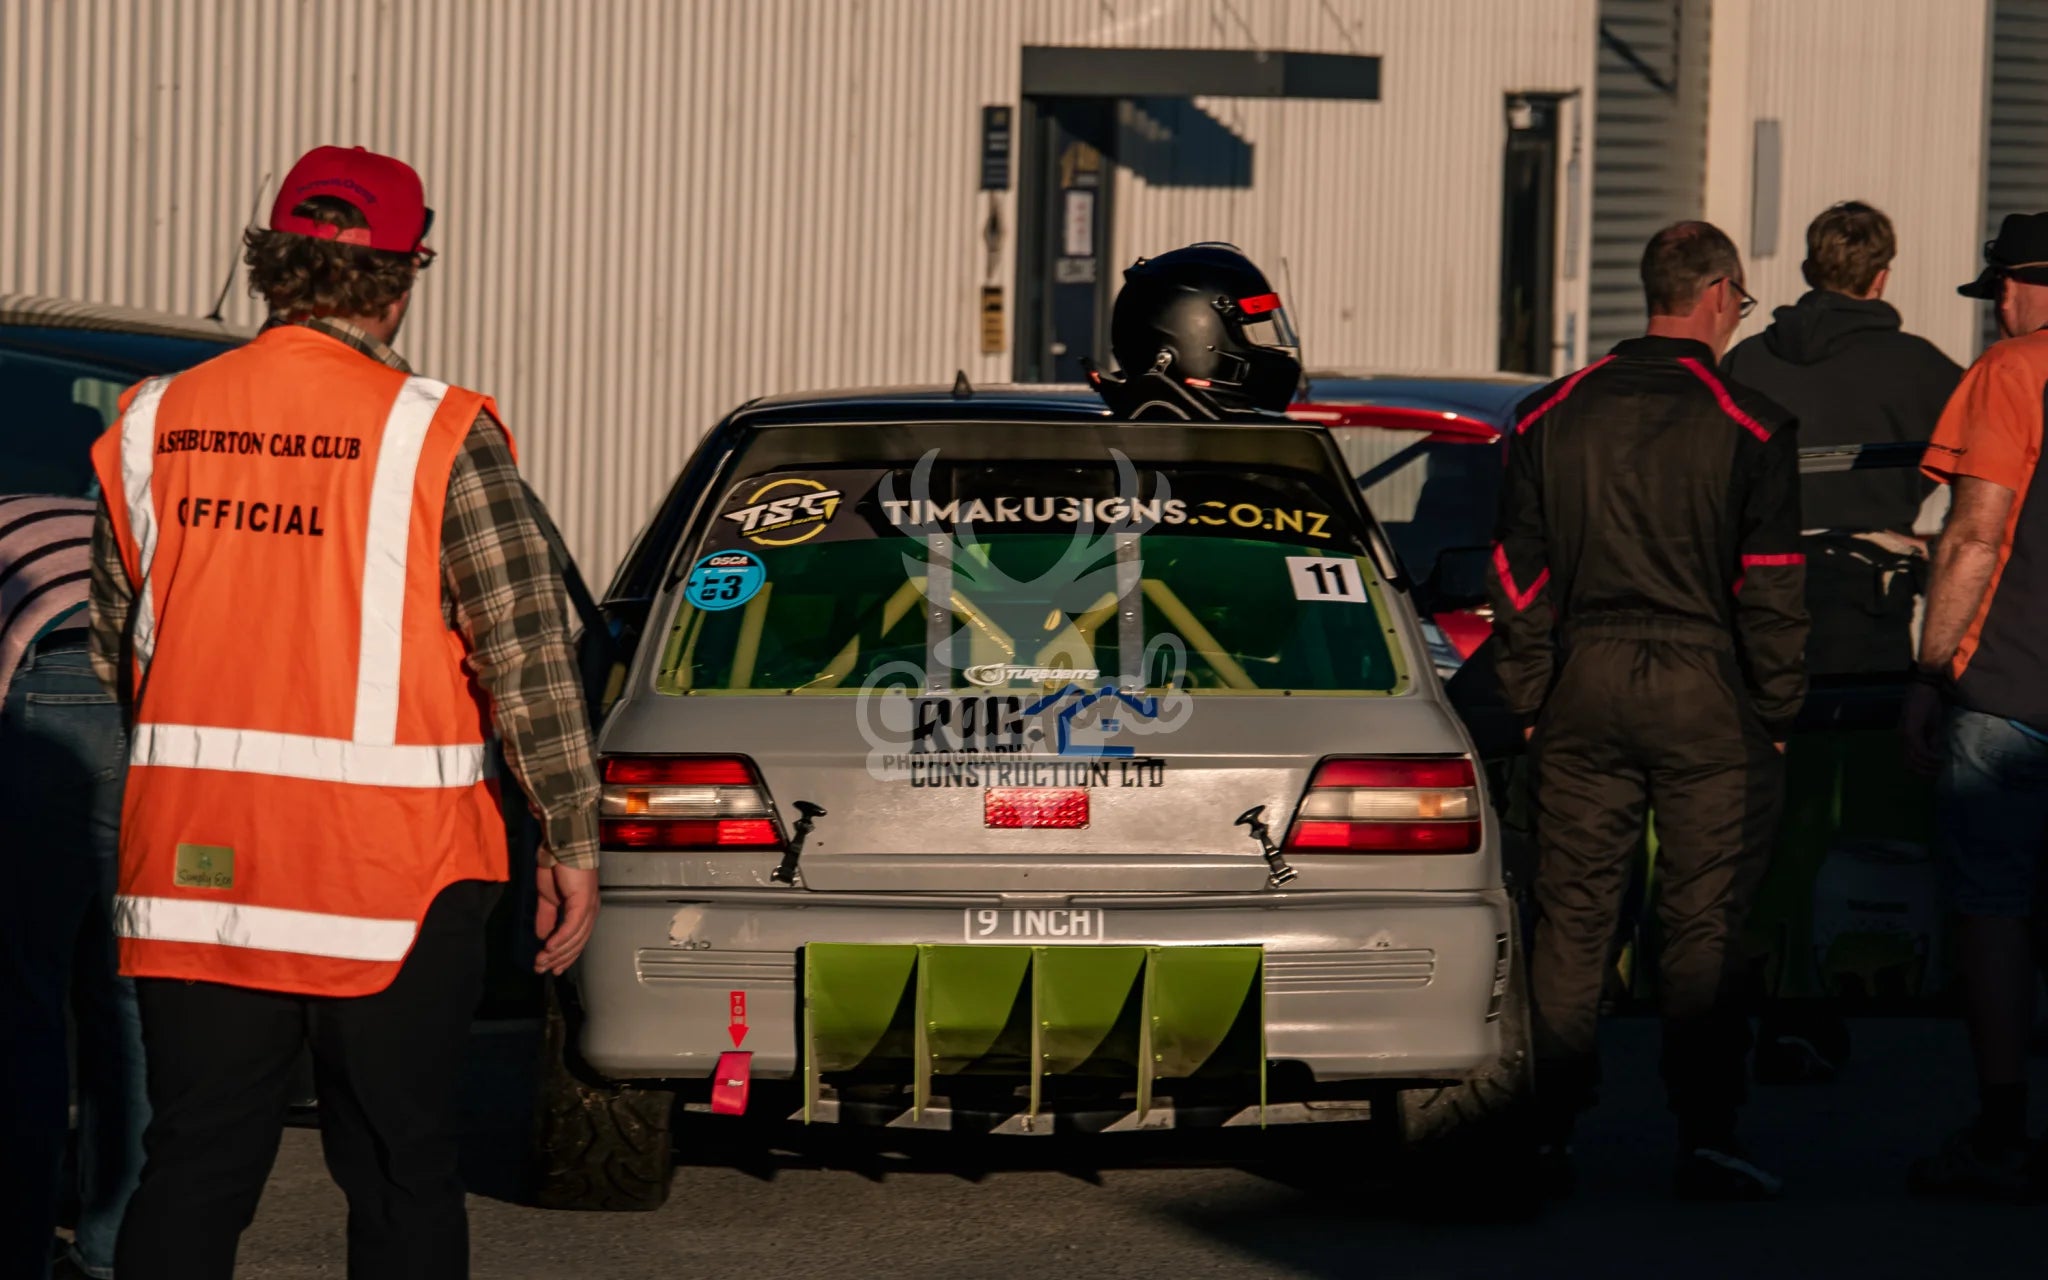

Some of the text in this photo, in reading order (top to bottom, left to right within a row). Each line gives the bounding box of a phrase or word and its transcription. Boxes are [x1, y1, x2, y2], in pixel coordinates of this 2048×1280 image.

[156, 429, 362, 460] ASHBURTON CAR CLUB
[177, 496, 325, 537] OFFICIAL
[882, 496, 1333, 539] TIMARUSIGNS.CO.NZ
[709, 556, 749, 567] OSCA
[720, 575, 743, 600] 3
[1304, 562, 1351, 596] 11
[1005, 668, 1100, 683] TURBOBITS
[910, 758, 1167, 788] CONSTRUCTION LTD
[977, 909, 1092, 937] 9 INCH
